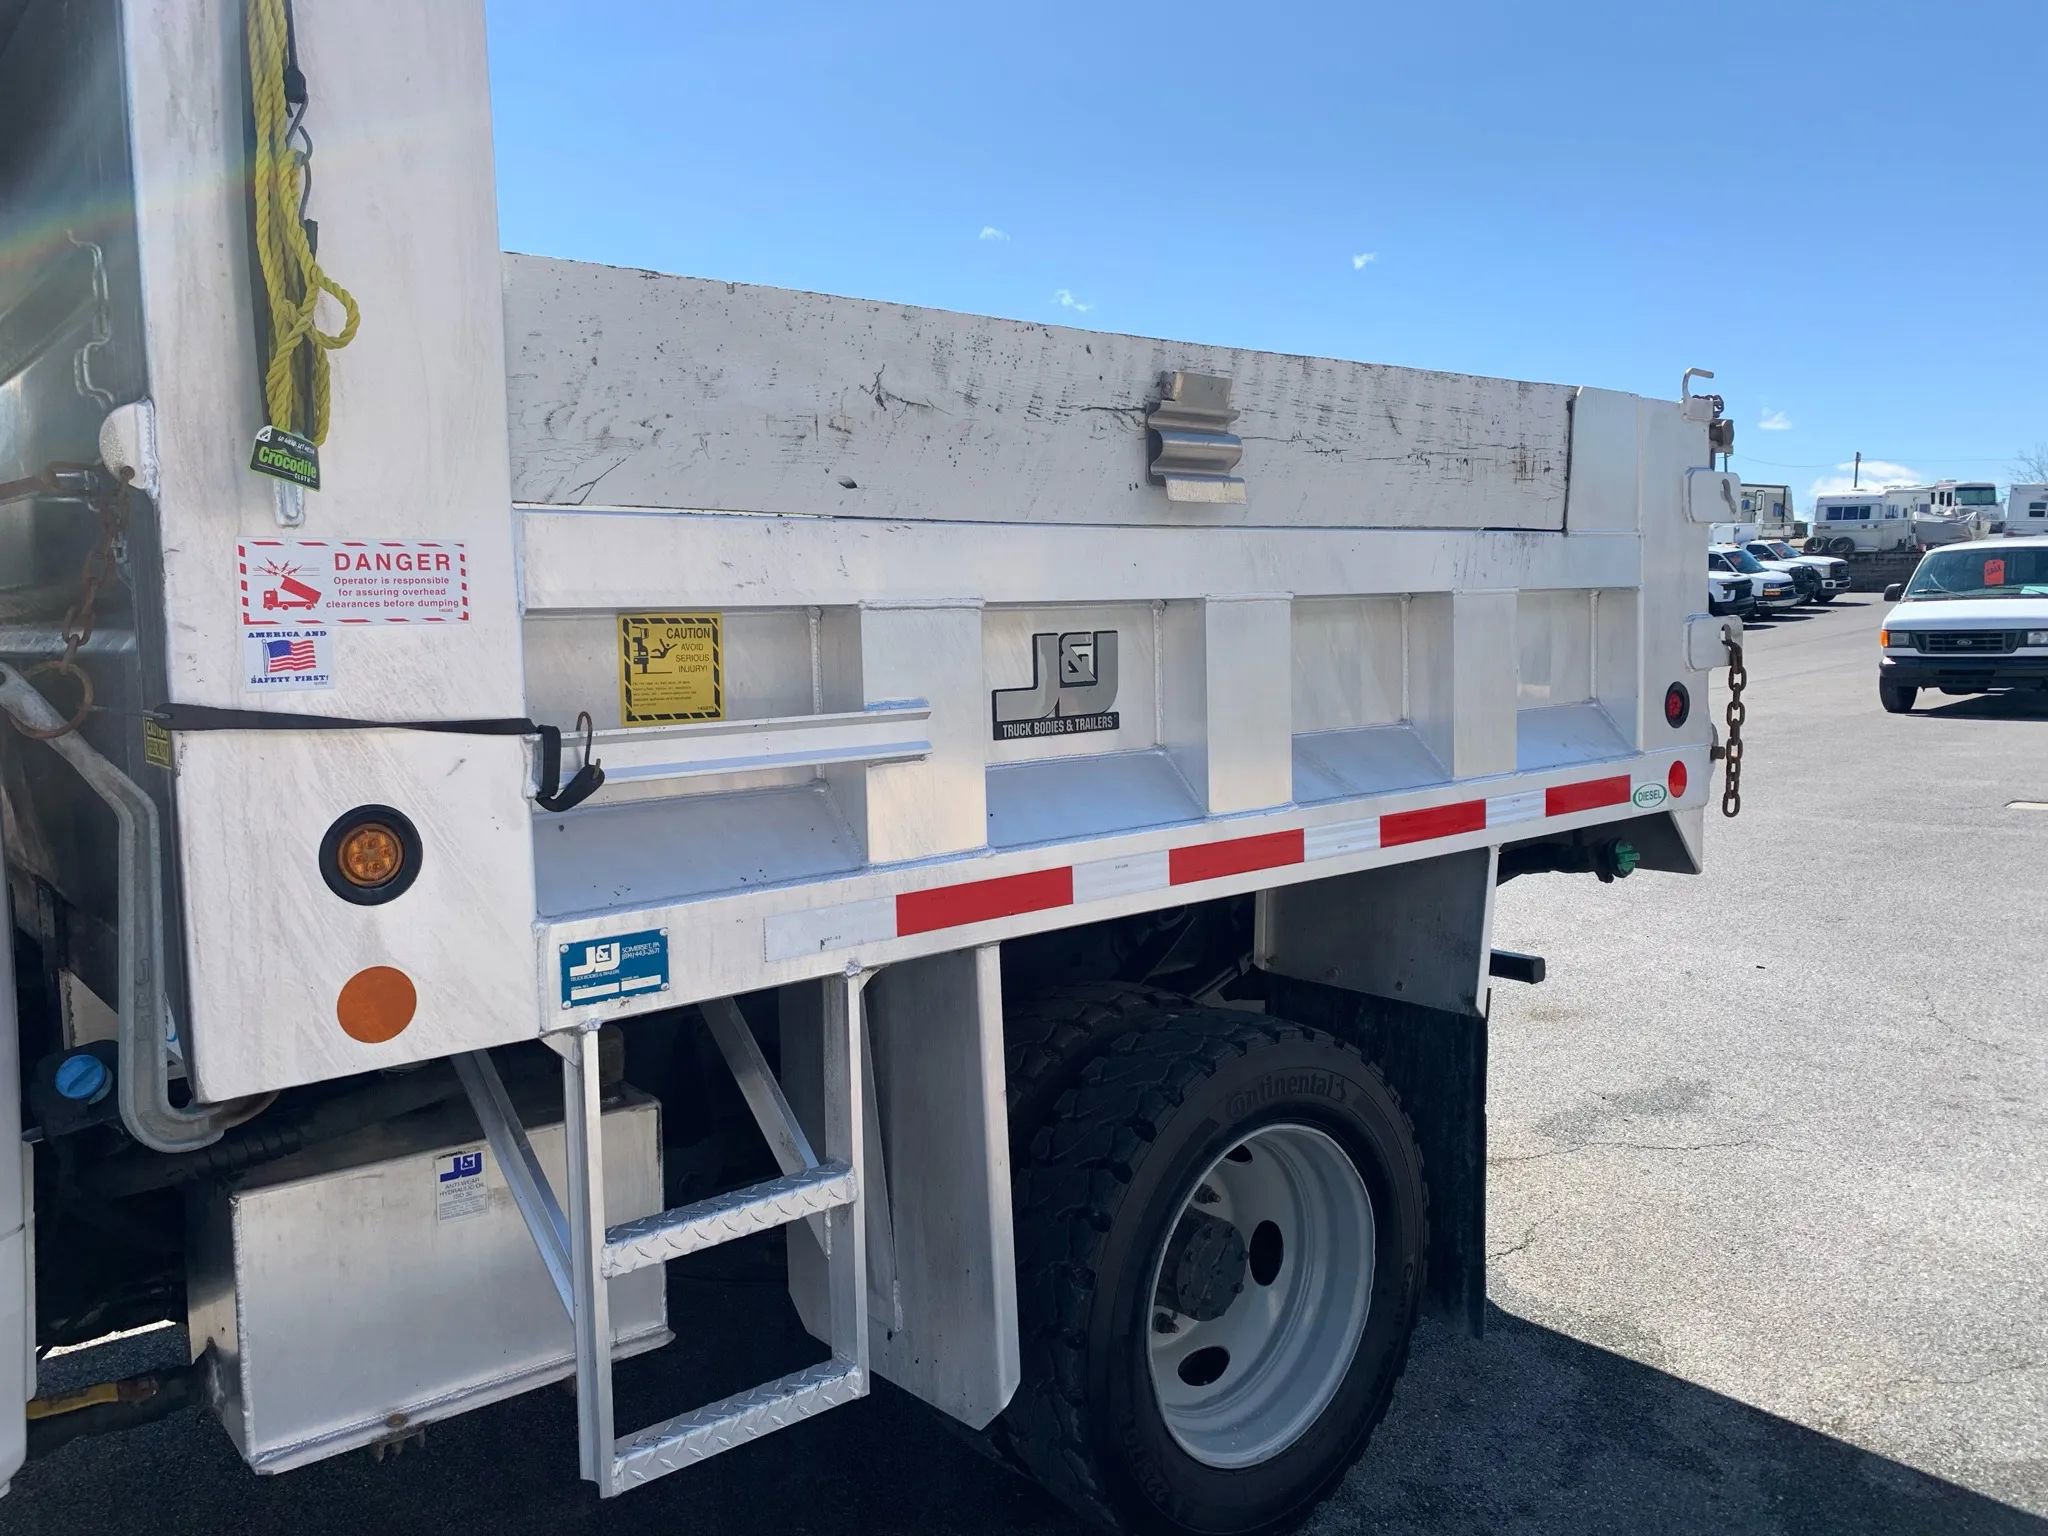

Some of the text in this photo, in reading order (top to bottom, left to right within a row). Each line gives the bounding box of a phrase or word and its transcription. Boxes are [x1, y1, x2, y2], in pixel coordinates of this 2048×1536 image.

[258, 446, 316, 478] Crocodile
[334, 552, 451, 571] DANGER
[334, 576, 449, 586] Operator is responsible
[338, 587, 446, 598] for assuring overhead
[326, 598, 459, 609] clearances before dumping
[248, 630, 300, 638] AMERICA
[666, 628, 710, 639] CAUTION
[681, 643, 704, 651] AVOID
[676, 654, 710, 662] SERIOUS
[250, 674, 329, 684] SAFETY FIRST!
[1002, 716, 1113, 738] TRUCK BODIES & TRAILERS
[1638, 789, 1662, 802] DIESEL
[1225, 1073, 1335, 1119] Continental
